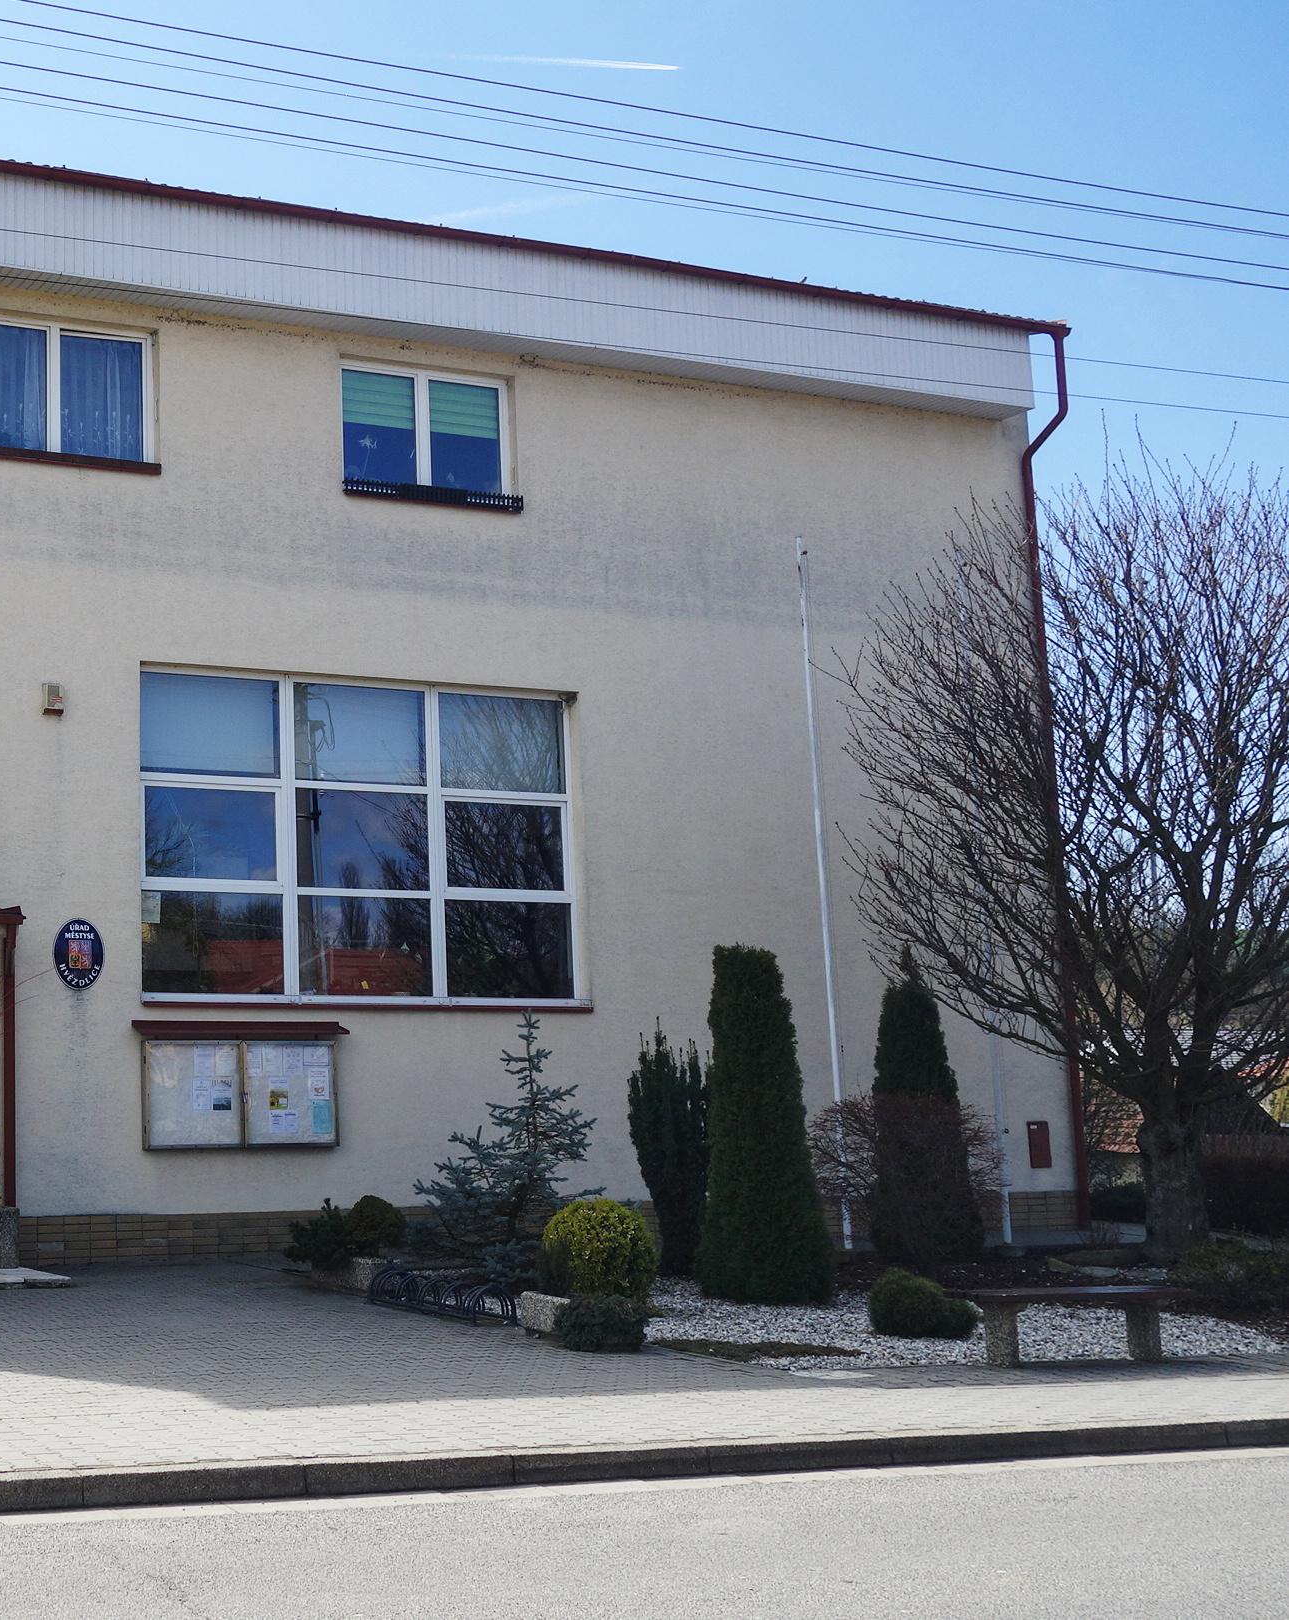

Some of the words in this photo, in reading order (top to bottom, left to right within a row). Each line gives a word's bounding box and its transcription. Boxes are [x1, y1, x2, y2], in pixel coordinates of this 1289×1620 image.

[69, 923, 90, 931] ÚŘAD
[64, 931, 95, 940] MĚSTYSE
[59, 963, 101, 987] HVĚZDLICE
